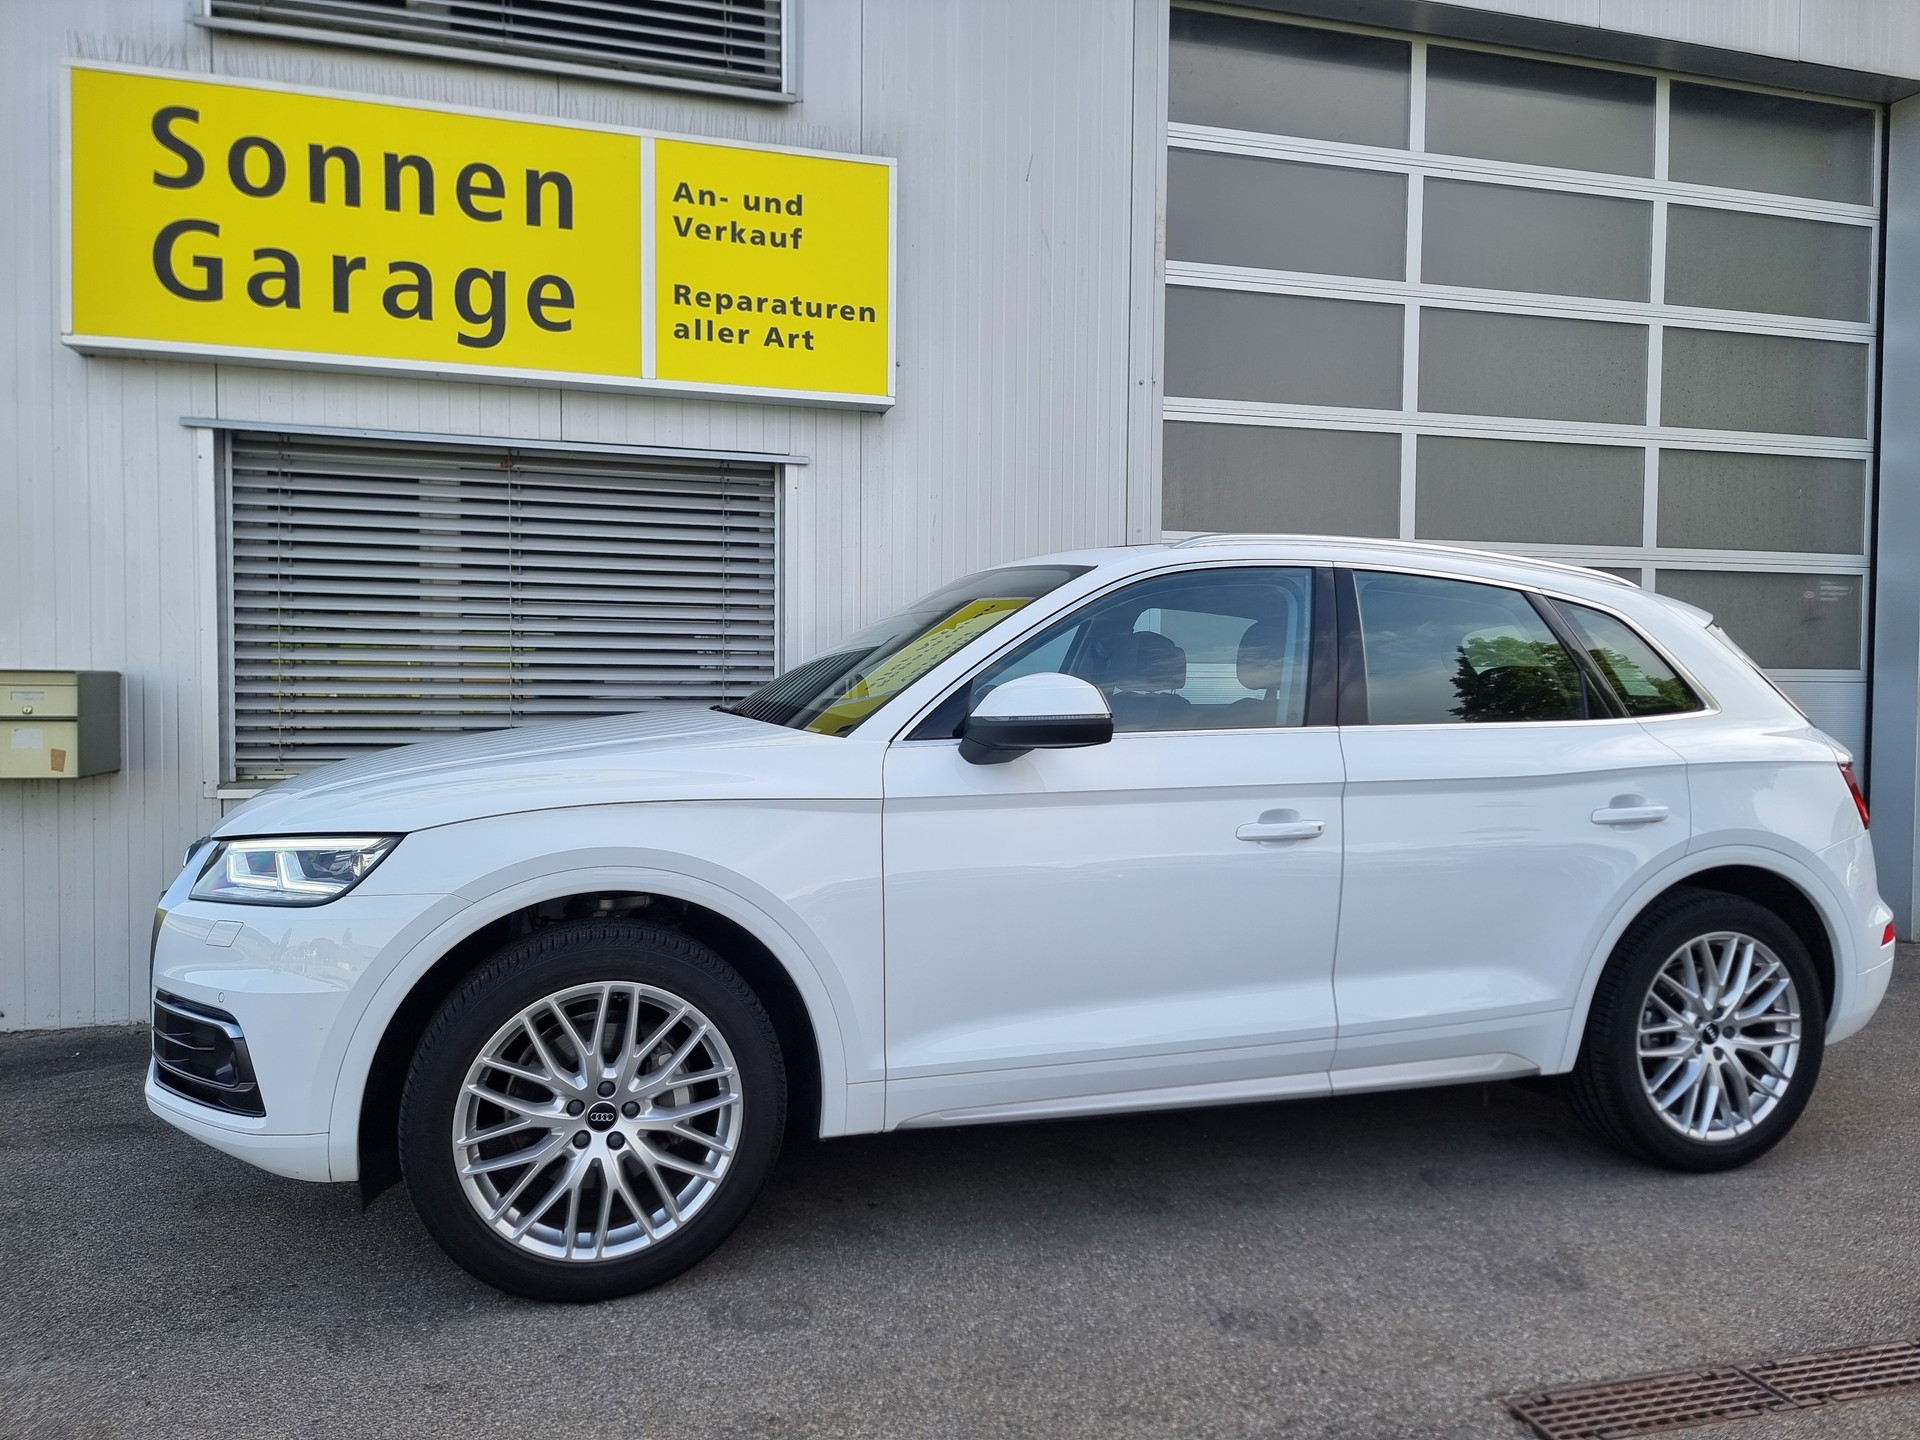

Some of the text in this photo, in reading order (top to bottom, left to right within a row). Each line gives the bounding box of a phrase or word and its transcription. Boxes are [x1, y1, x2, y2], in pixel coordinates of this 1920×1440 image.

[151, 105, 574, 231] Sonnen
[672, 181, 803, 217] An- und
[672, 215, 803, 250] Verkauf
[152, 218, 575, 349] Garage
[674, 283, 876, 323] Reparaturen
[673, 318, 814, 351] aller Art
